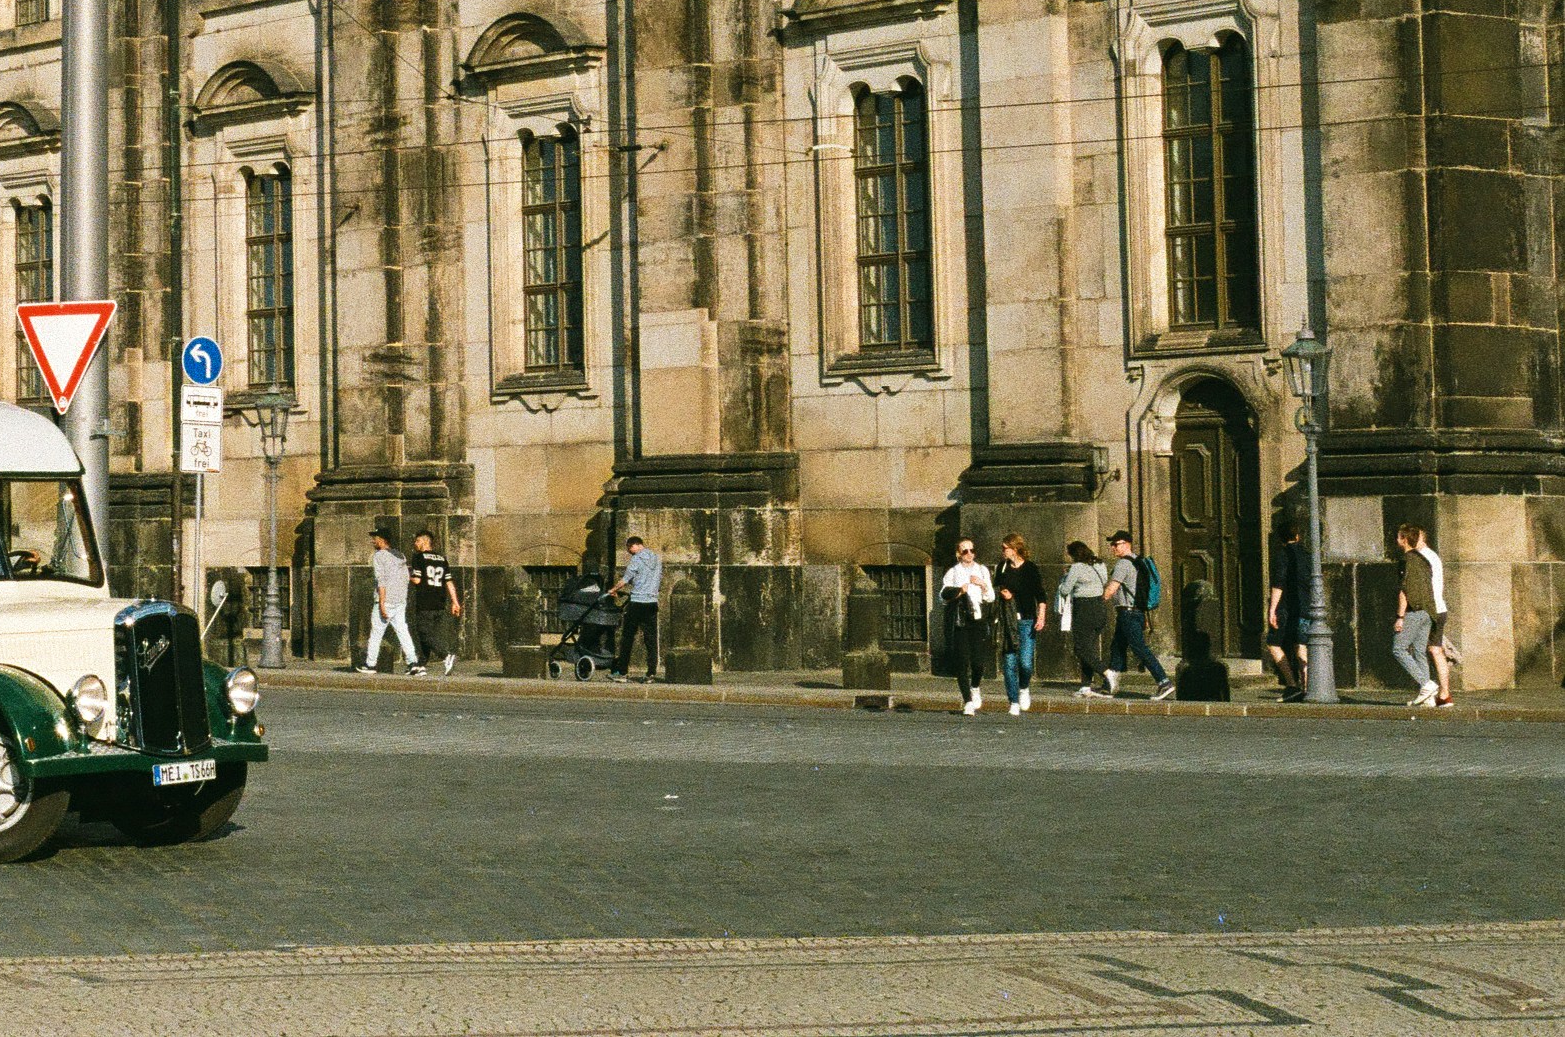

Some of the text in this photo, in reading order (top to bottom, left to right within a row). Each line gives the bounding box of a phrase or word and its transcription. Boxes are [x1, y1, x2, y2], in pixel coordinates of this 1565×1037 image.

[193, 428, 211, 439] Taxi
[194, 458, 210, 468] frei
[426, 565, 444, 587] 92
